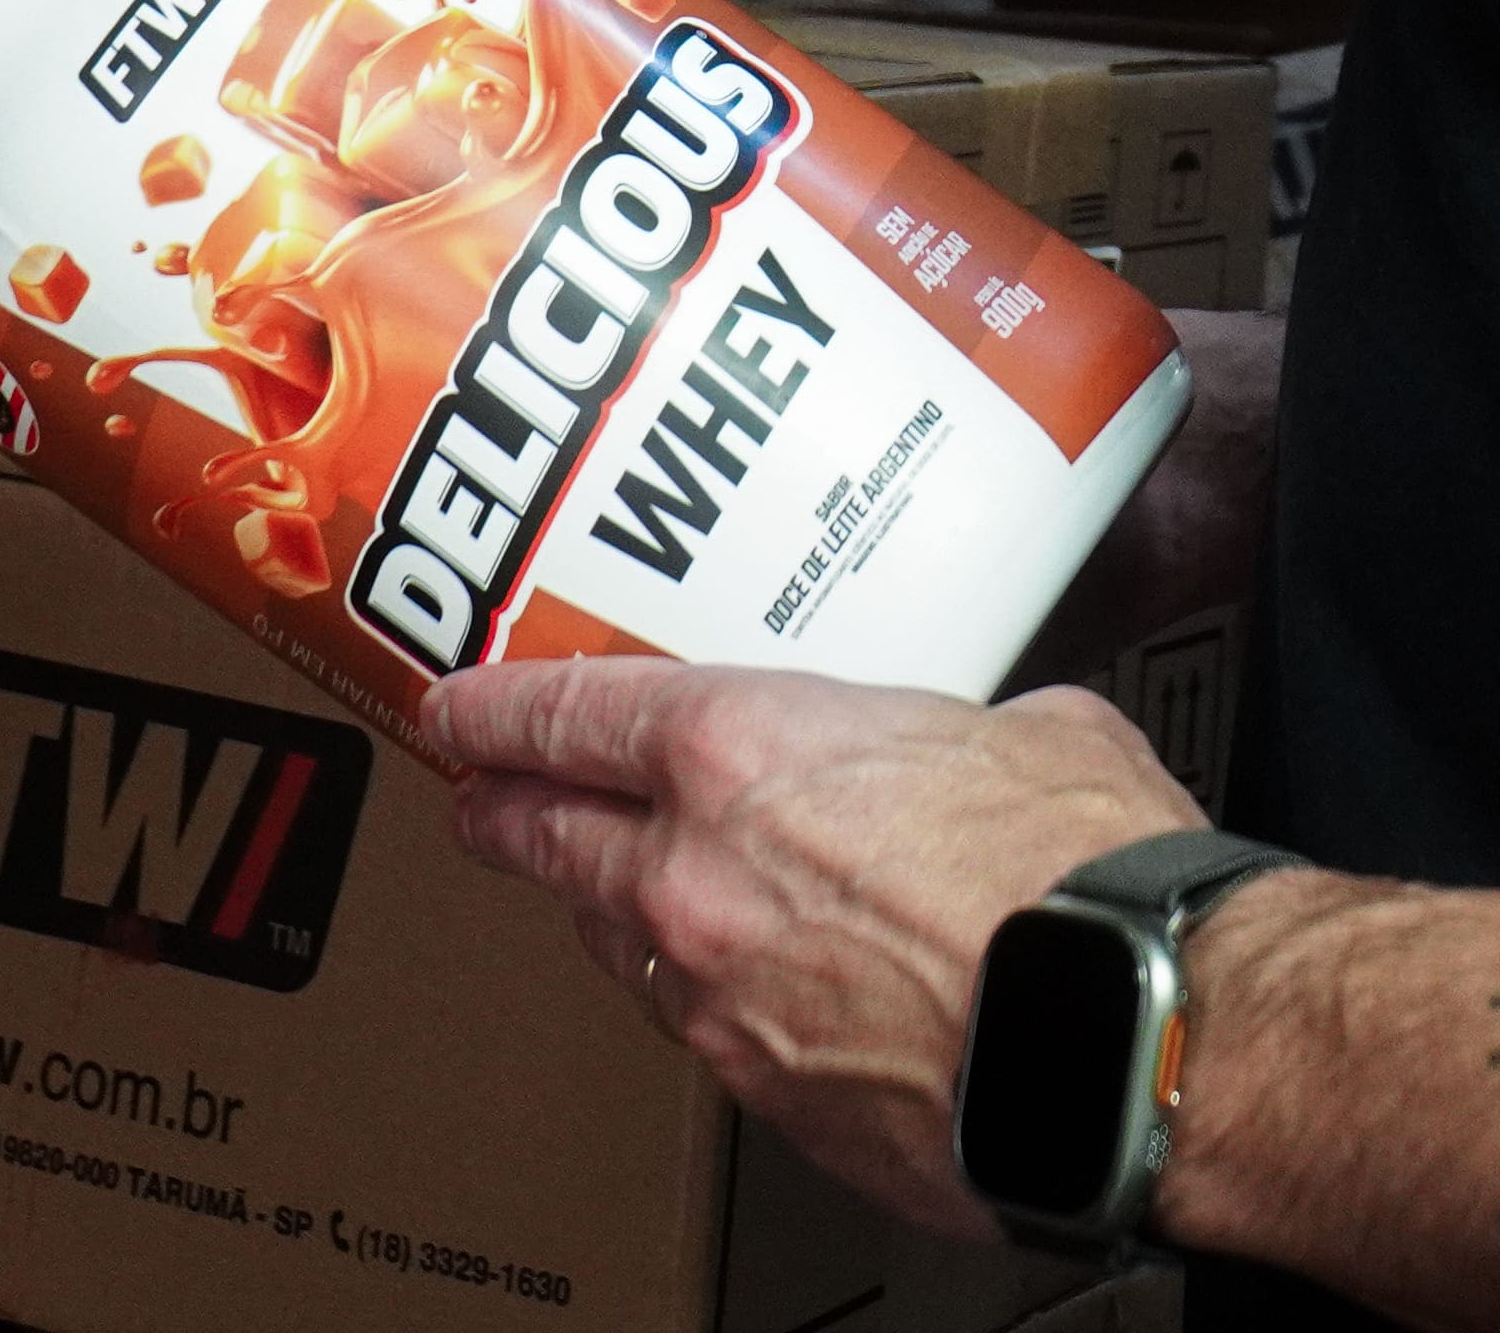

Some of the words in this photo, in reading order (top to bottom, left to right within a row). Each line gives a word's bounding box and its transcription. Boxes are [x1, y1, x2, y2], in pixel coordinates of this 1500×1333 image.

[875, 205, 916, 246] SEM
[913, 230, 973, 294] AÇÚCAR
[980, 281, 1046, 340] 900g
[366, 35, 774, 670] DELICIOUS
[590, 247, 836, 585] WHEY
[763, 574, 810, 635] DOCE
[801, 546, 830, 583] DE
[821, 496, 869, 554] LEITE
[860, 399, 943, 504] ARGENTINO
[815, 474, 852, 524] SABOR
[126, 1165, 249, 1226] TARUMÃ
[273, 1204, 313, 1240] SP
[356, 1225, 413, 1274] (18)
[418, 1241, 572, 1308] 3329-1630
